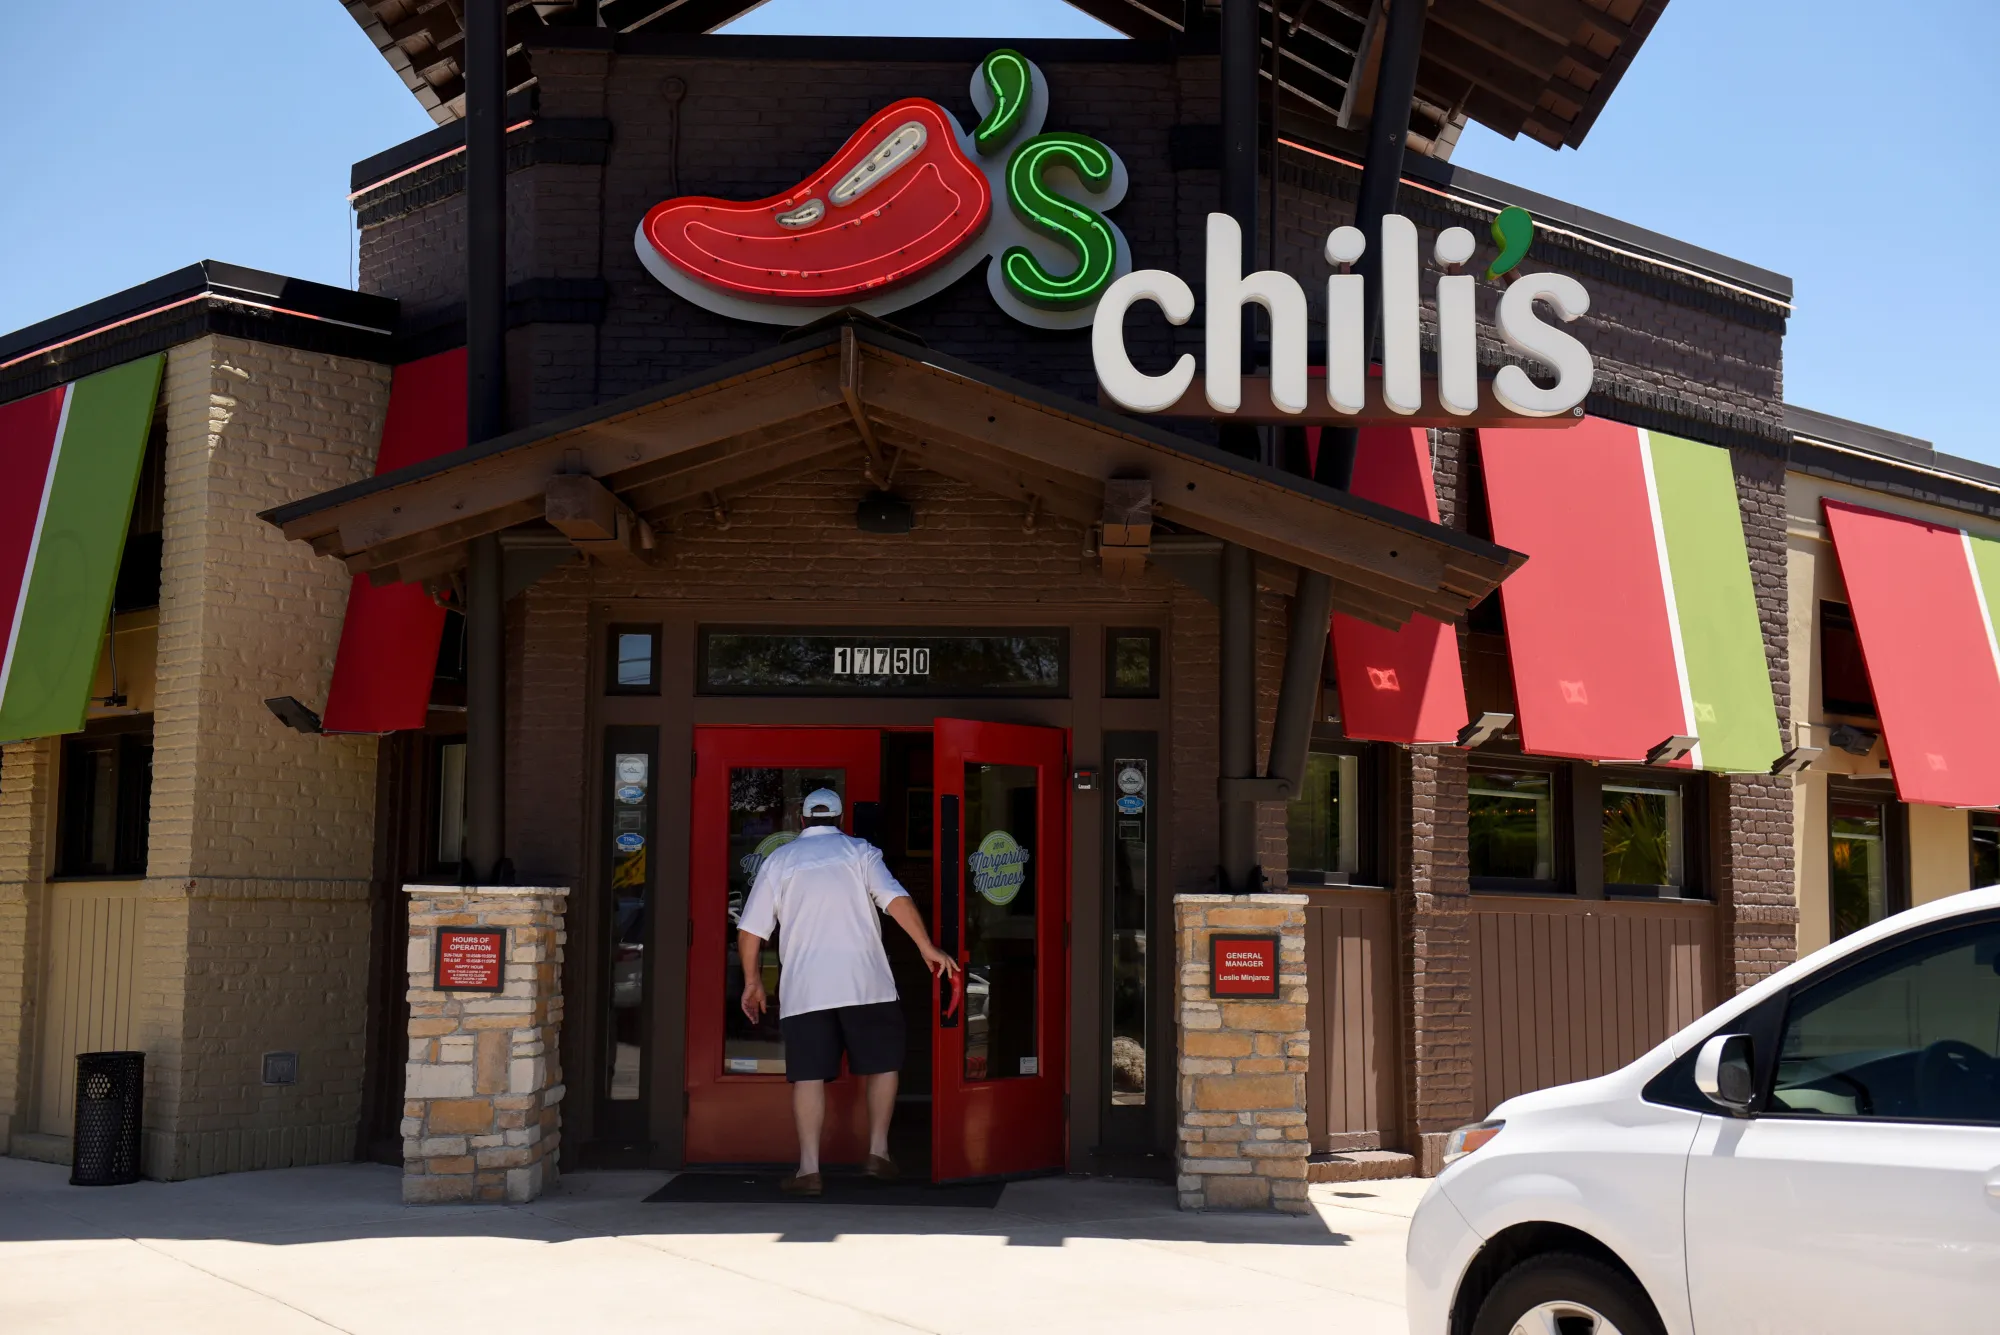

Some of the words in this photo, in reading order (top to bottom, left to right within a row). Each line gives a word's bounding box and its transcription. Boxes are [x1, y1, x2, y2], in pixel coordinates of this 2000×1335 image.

[1091, 205, 1594, 418] chili's
[837, 648, 929, 674] 17750
[968, 845, 1029, 872] Margarita
[973, 870, 1025, 893] Madness
[1240, 974, 1270, 983] Minjarez
